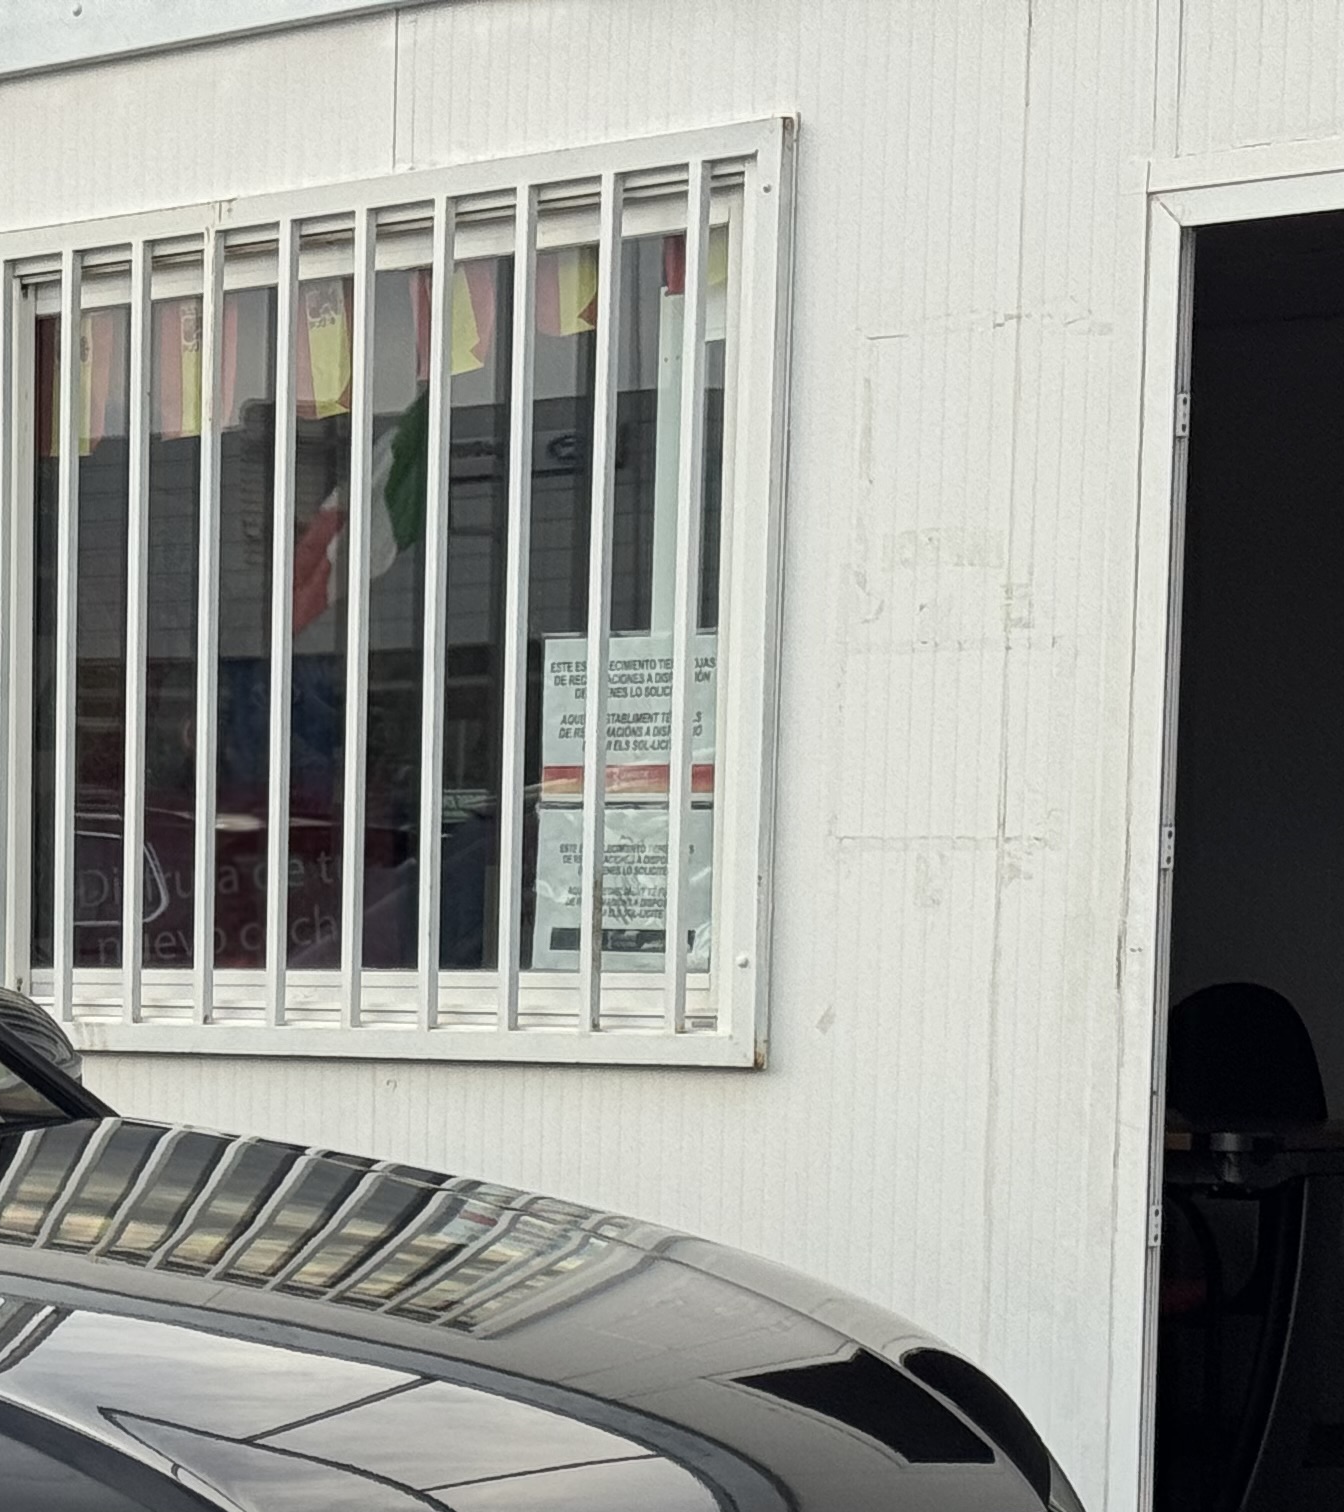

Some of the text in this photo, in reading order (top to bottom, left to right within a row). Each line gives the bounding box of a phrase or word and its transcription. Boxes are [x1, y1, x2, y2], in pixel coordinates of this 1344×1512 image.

[550, 661, 573, 673] ESTE
[575, 659, 657, 672] ESECIMIENTO
[554, 675, 567, 686] DE
[569, 672, 645, 685] RECACIONES
[630, 685, 642, 698] LO
[558, 727, 572, 739] DE
